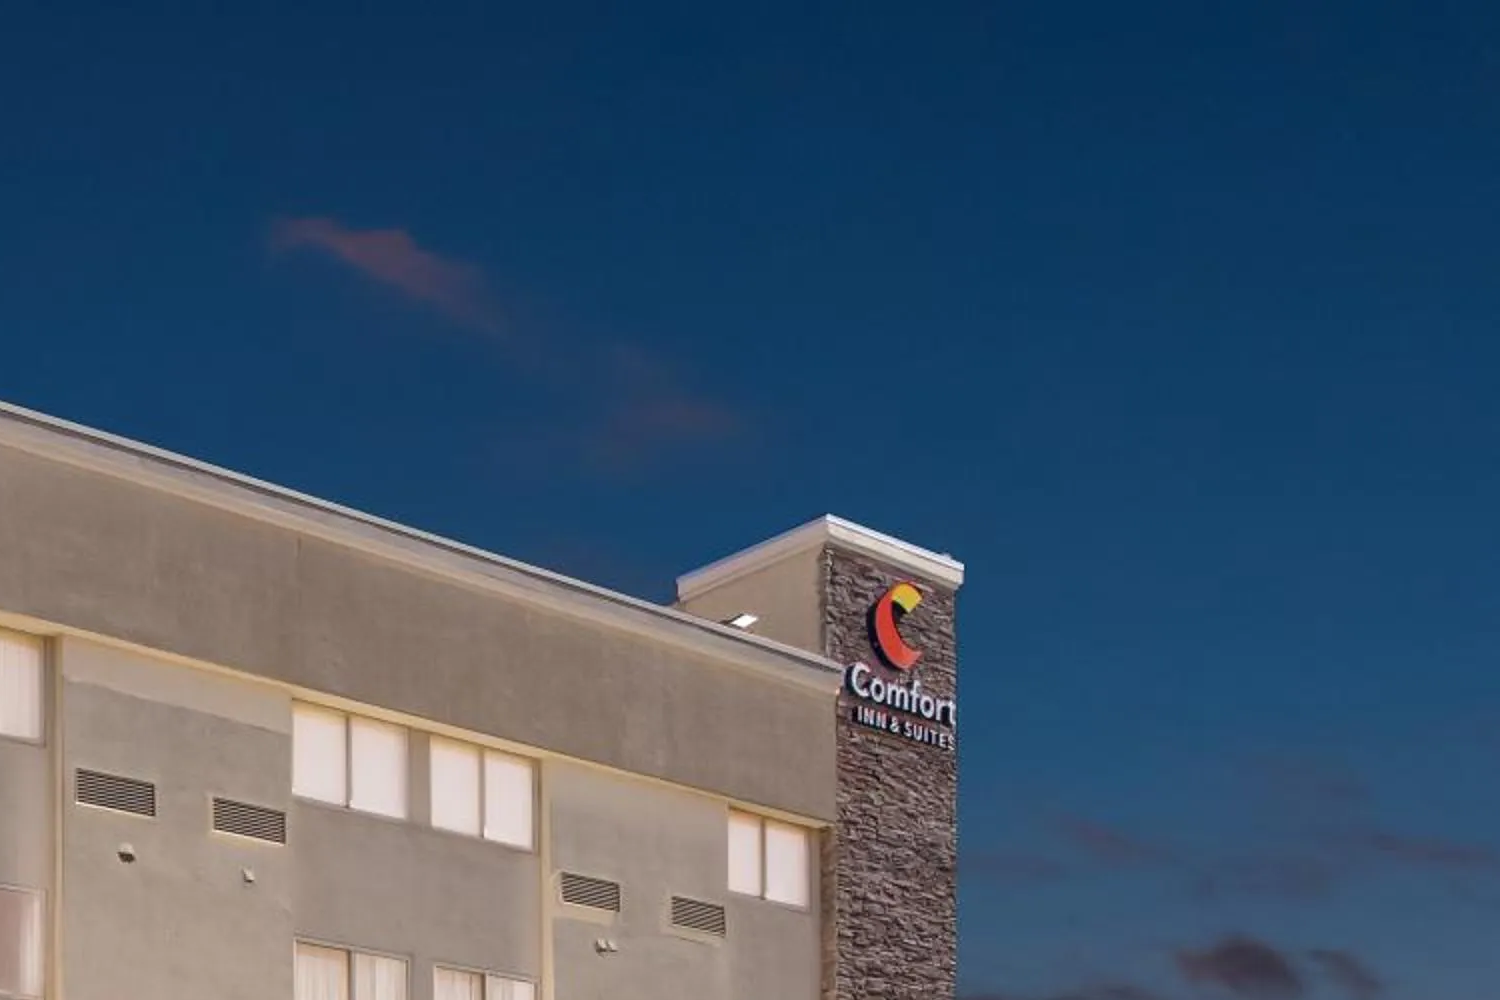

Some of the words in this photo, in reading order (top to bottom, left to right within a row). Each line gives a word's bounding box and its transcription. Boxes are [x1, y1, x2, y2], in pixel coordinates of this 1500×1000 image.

[851, 661, 957, 726] Comfort
[857, 705, 888, 729] INN
[890, 716, 901, 733] &
[903, 721, 956, 751] SUITES
